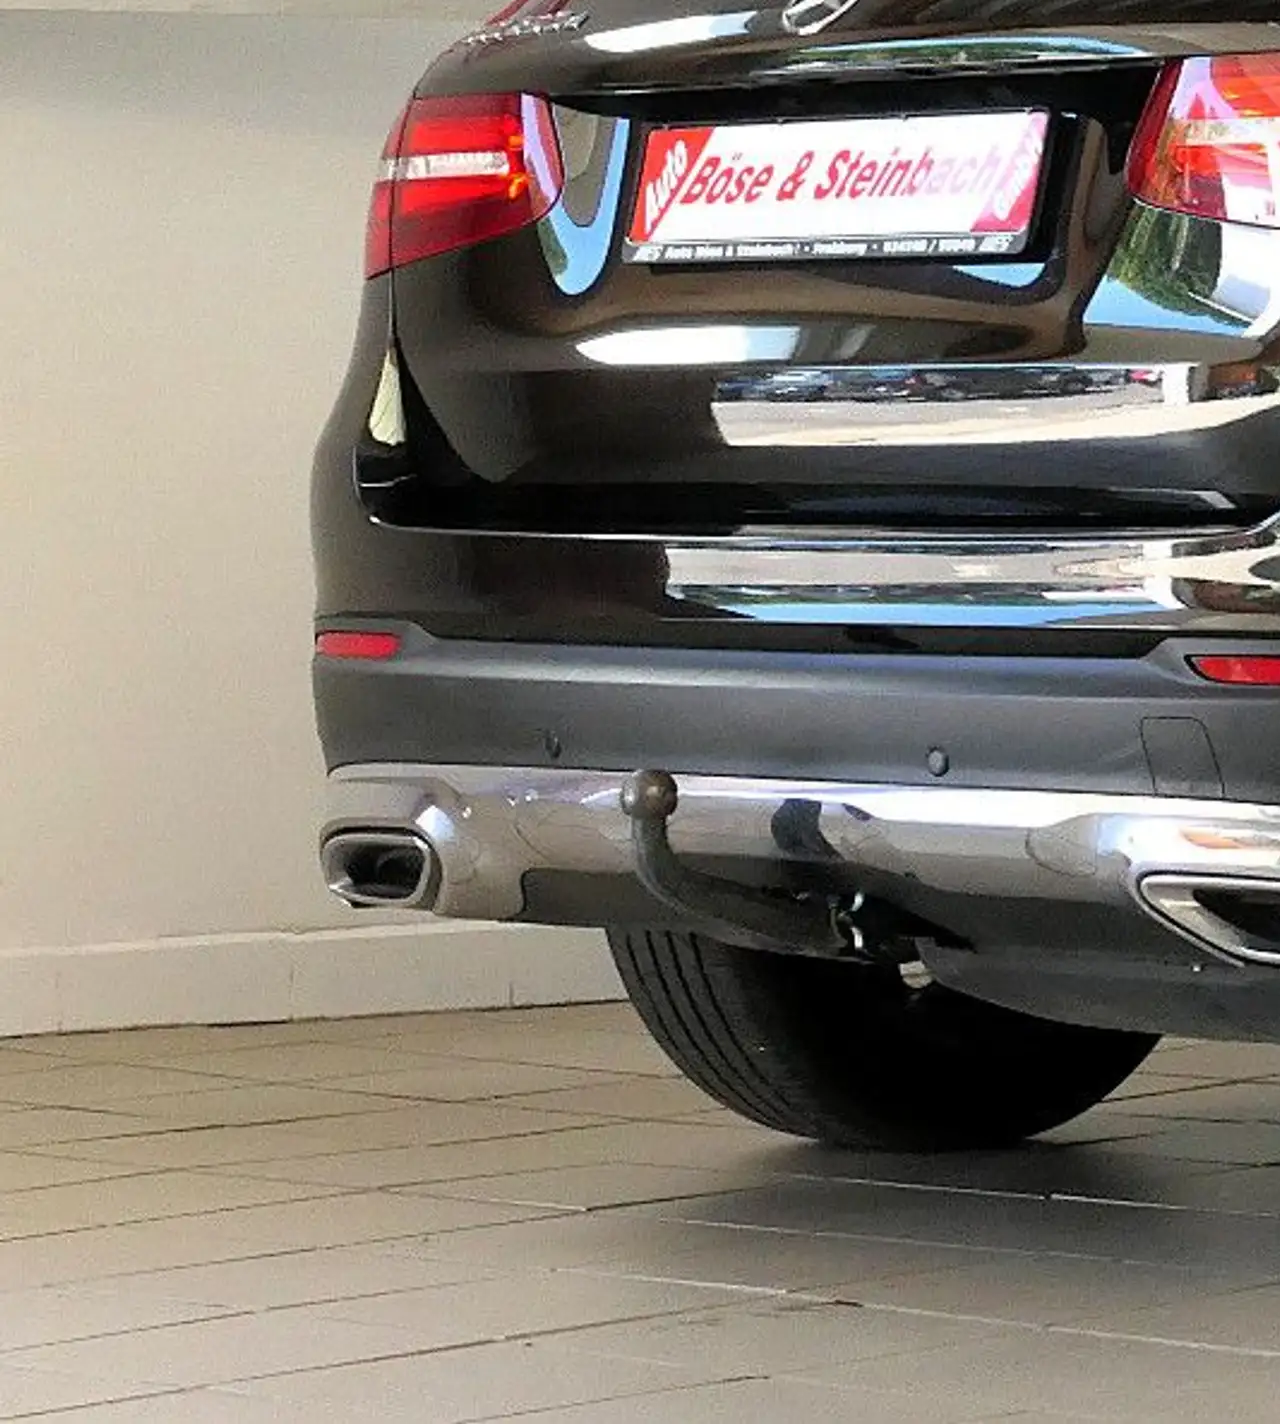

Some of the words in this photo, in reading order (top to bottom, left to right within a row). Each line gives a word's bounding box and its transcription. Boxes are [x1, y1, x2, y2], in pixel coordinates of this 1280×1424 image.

[645, 139, 688, 234] Auto
[680, 153, 774, 204] Böse
[776, 150, 814, 201] &
[814, 144, 1002, 201] Steinbach
